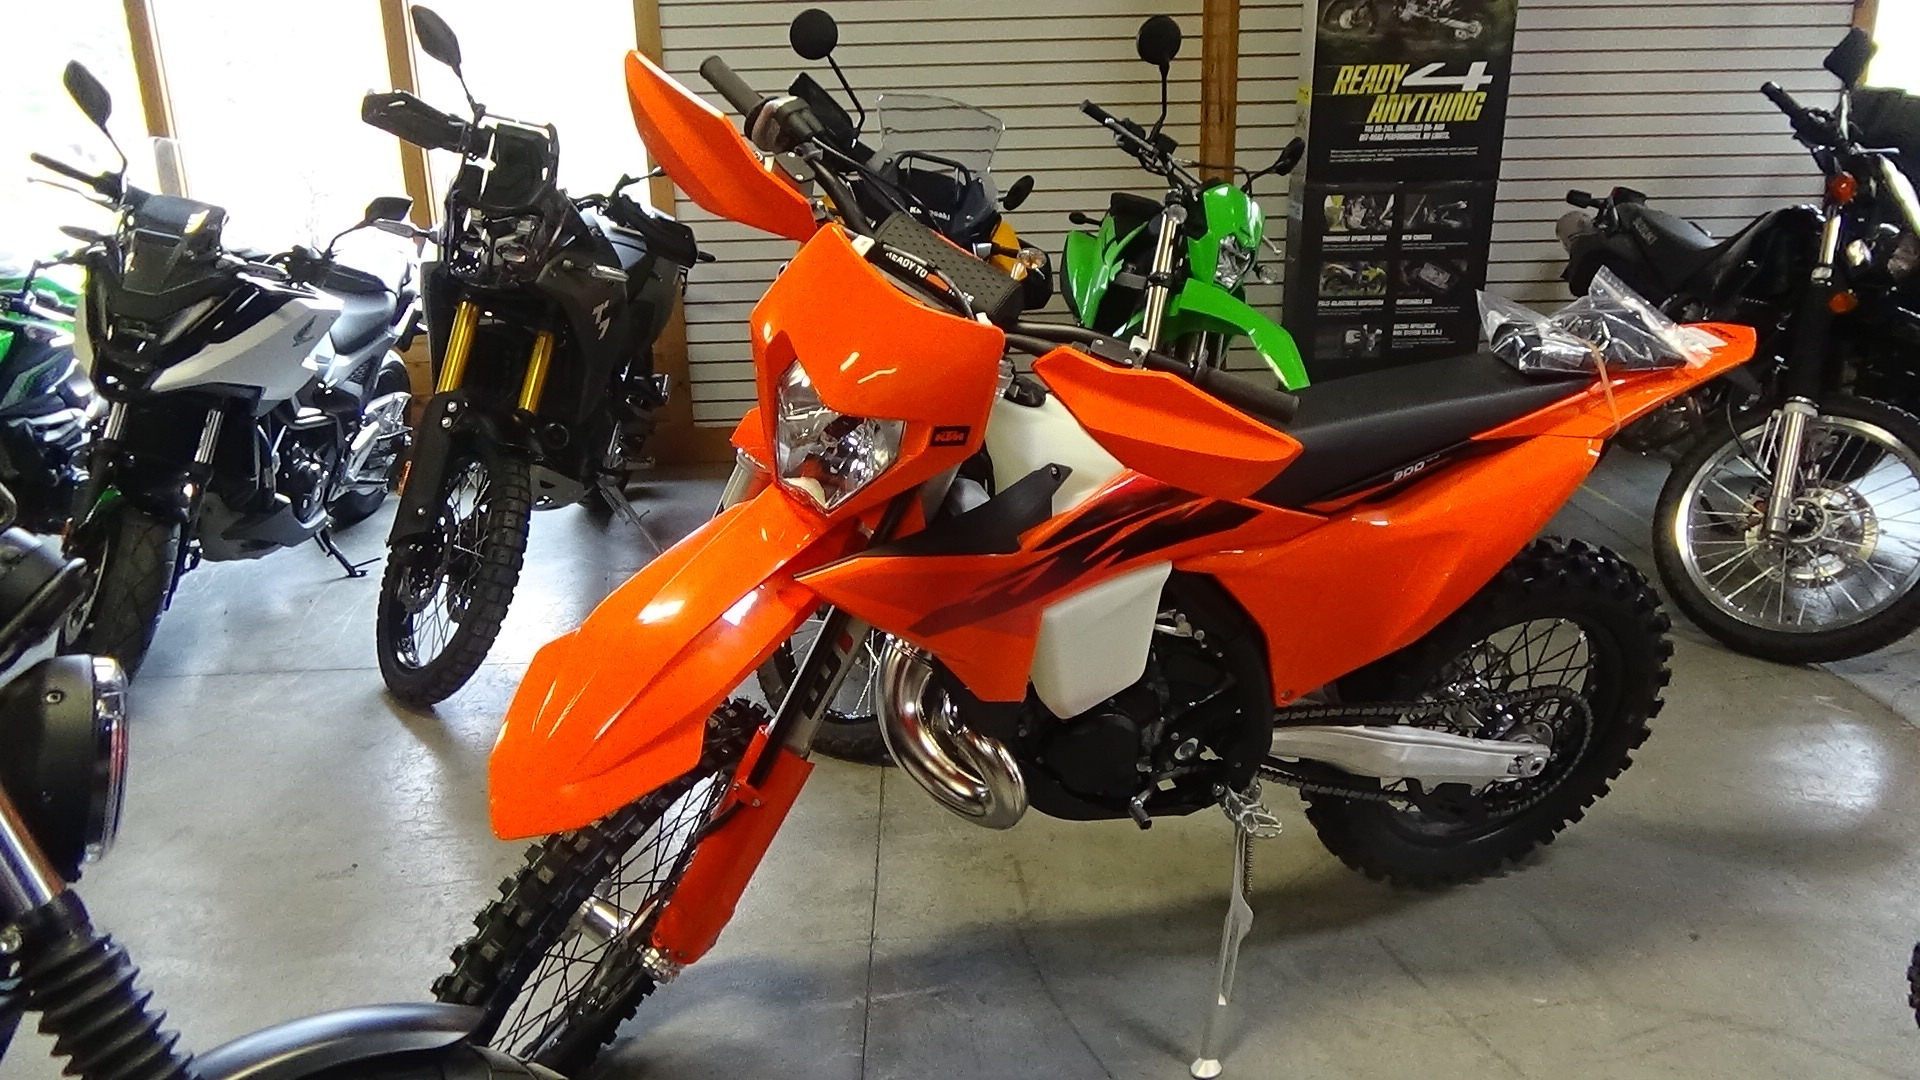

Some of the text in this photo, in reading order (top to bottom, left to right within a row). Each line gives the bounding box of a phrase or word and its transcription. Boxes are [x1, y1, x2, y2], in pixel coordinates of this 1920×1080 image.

[1332, 61, 1493, 95] READY 4
[1366, 91, 1488, 124] ANYTHING
[914, 265, 929, 279] TO
